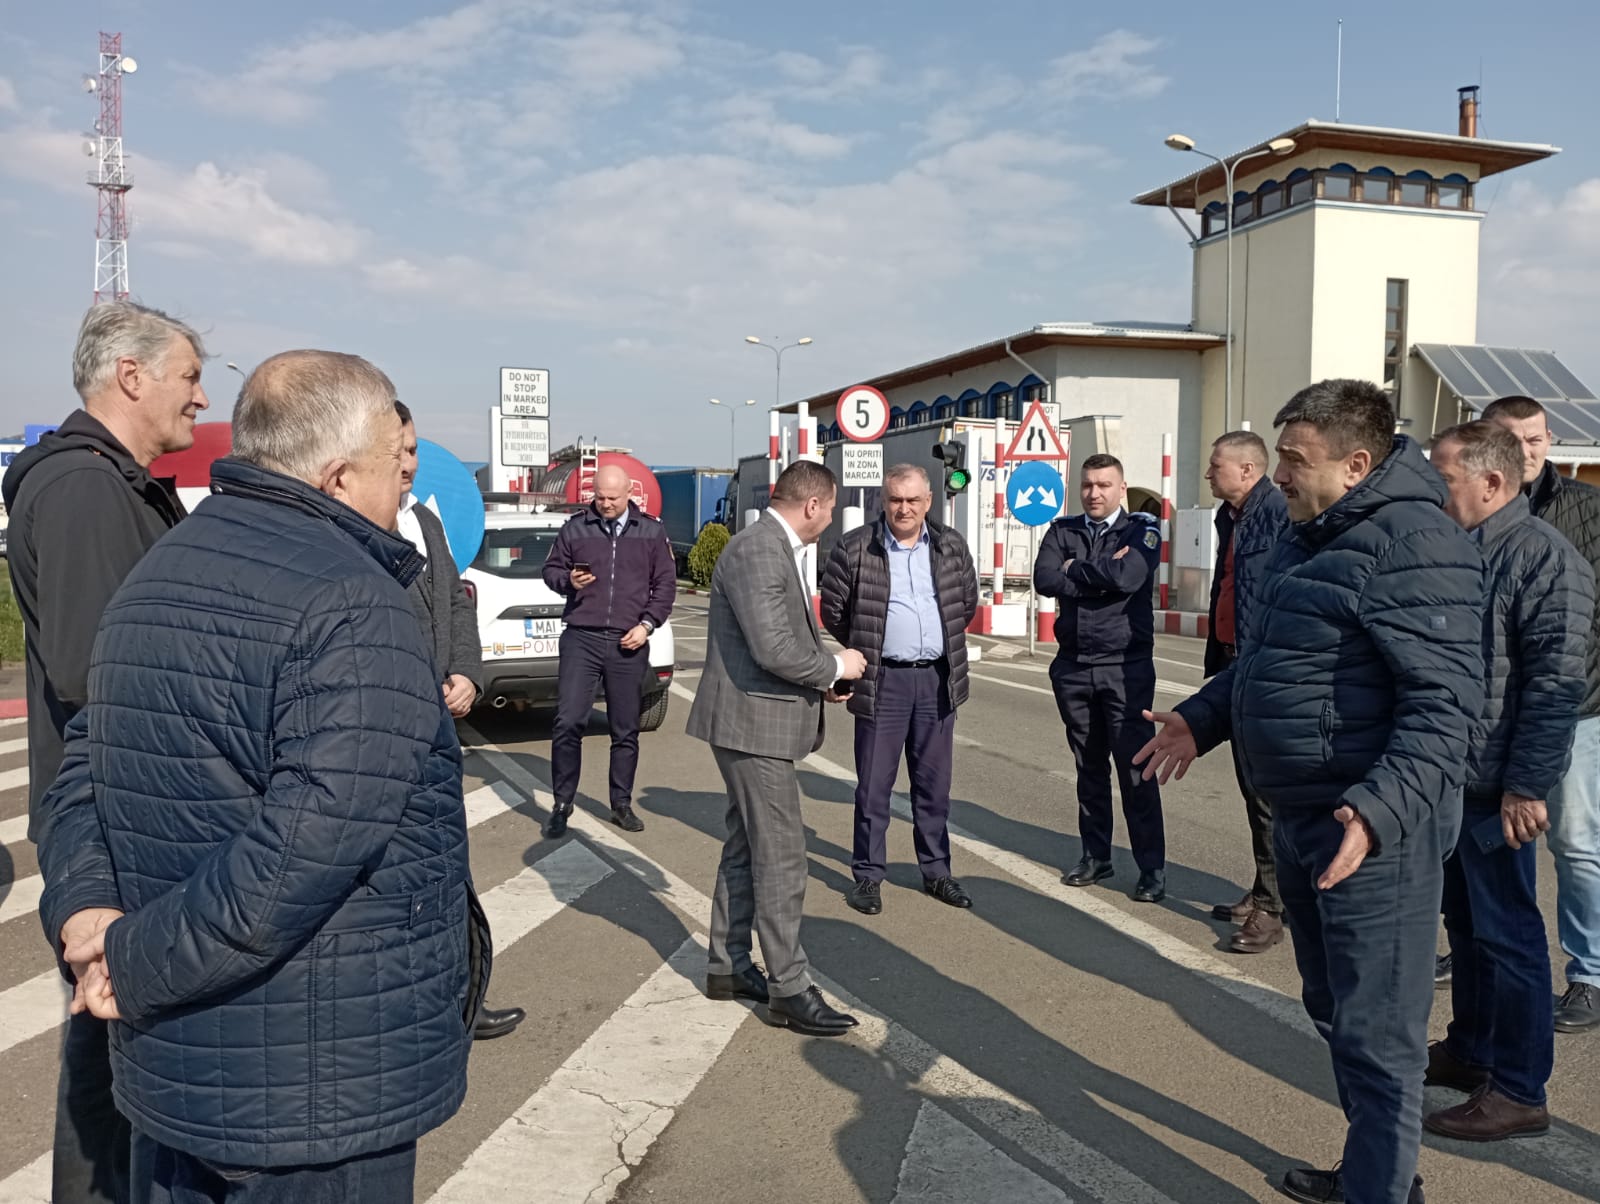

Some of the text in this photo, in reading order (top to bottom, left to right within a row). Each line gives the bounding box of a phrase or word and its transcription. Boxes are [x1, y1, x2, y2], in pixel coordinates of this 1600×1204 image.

[509, 372, 541, 382] DO NOT
[514, 384, 536, 392] STOP
[503, 394, 547, 404] IN MARKED
[513, 405, 537, 414] AREA
[856, 399, 870, 429] 5
[844, 450, 855, 458] NU
[848, 460, 878, 469] IN ZONA
[844, 471, 881, 479] MARCATA
[536, 620, 555, 632] MAI
